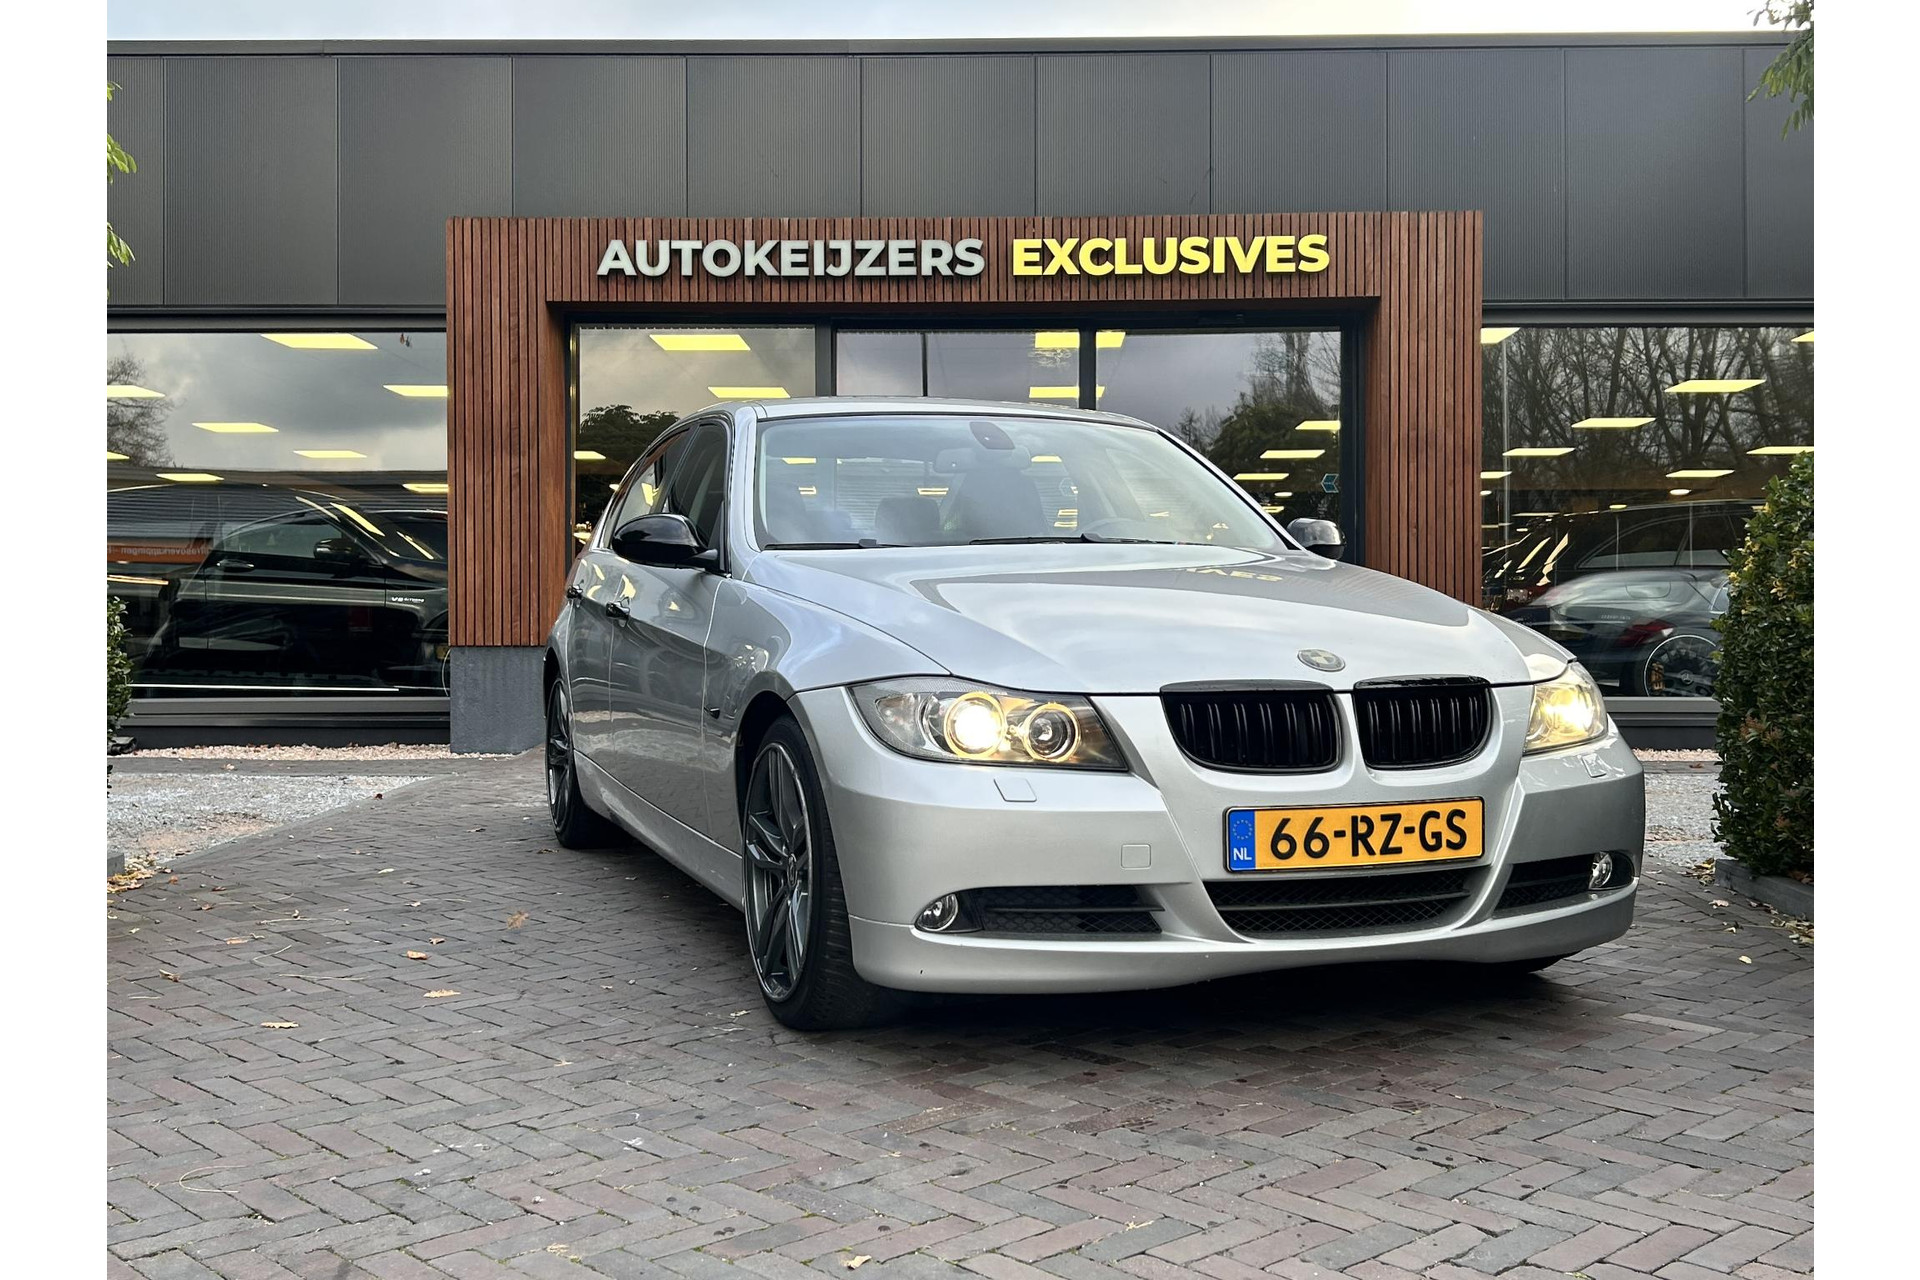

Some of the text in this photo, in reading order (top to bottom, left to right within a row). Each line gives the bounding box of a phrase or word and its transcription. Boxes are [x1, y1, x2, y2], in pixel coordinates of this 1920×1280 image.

[597, 234, 1330, 278] AUTOKEIJZERS EXCLUSIVES
[1233, 847, 1252, 861] NL
[1270, 808, 1467, 861] 66-RZ-GS
